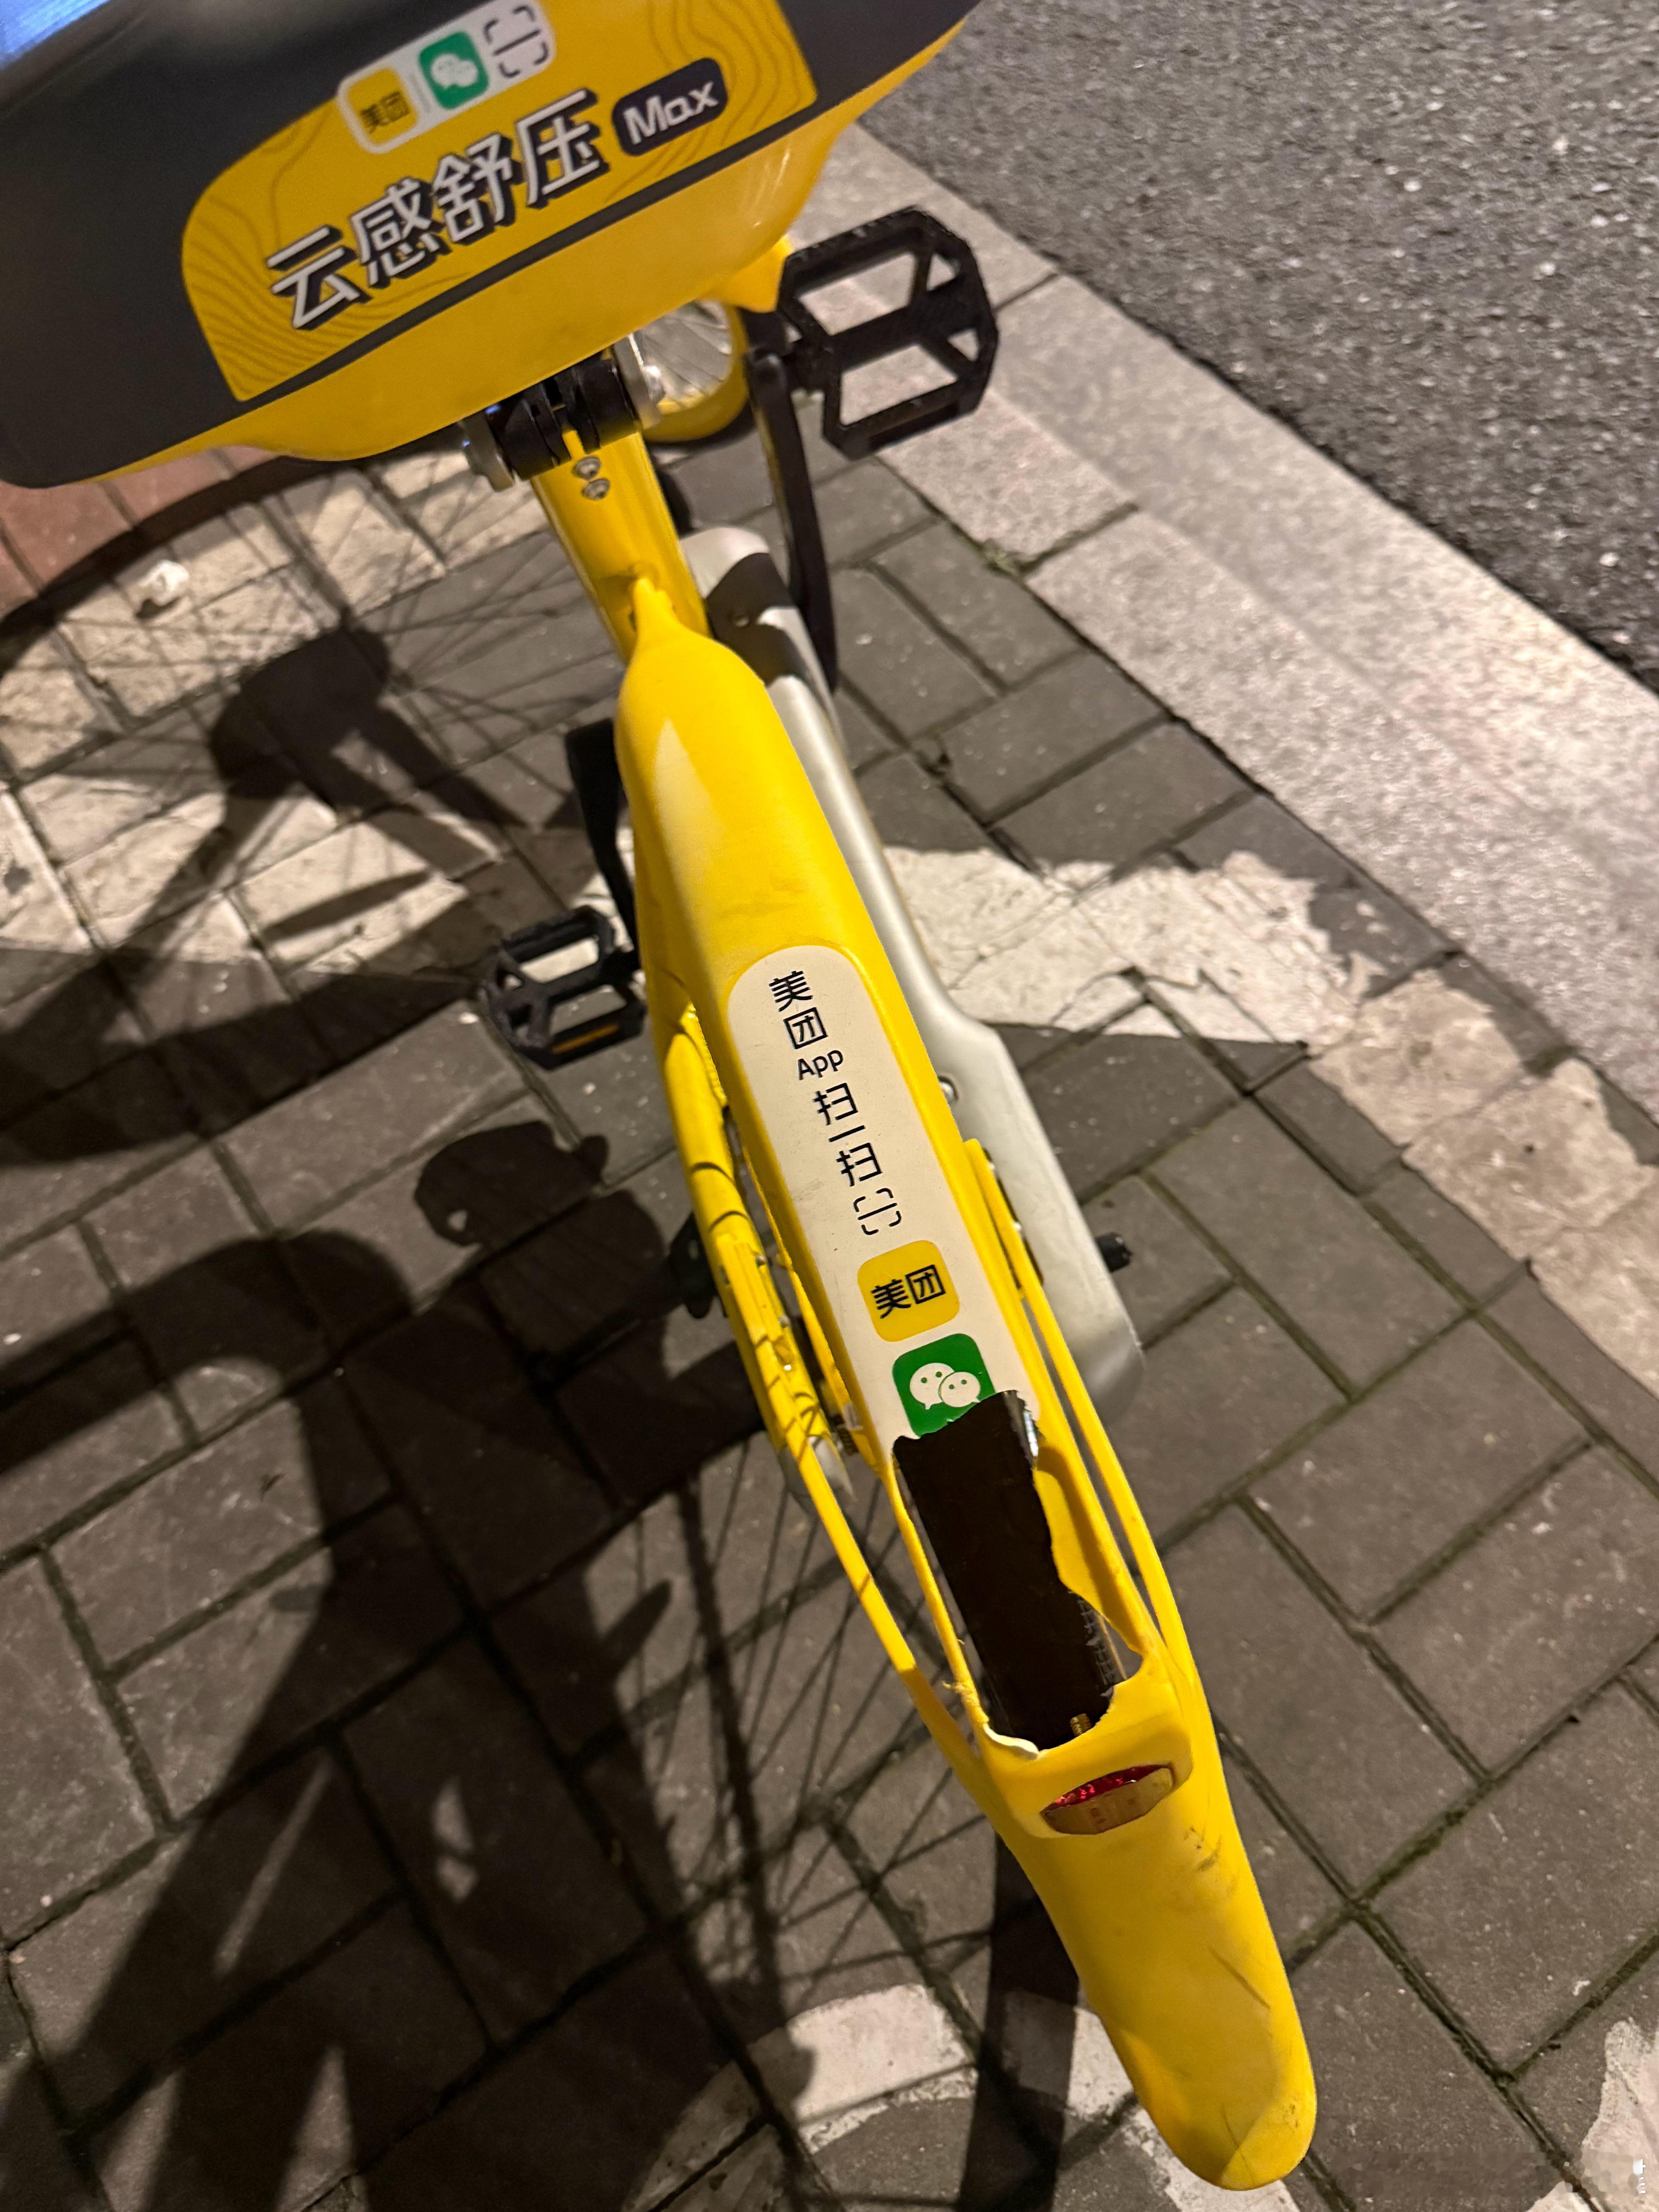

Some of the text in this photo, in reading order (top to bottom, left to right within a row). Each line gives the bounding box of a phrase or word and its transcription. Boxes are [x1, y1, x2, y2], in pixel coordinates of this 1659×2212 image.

[266, 81, 718, 329] 云感舒压 Max
[871, 1265, 946, 1319] 美团
